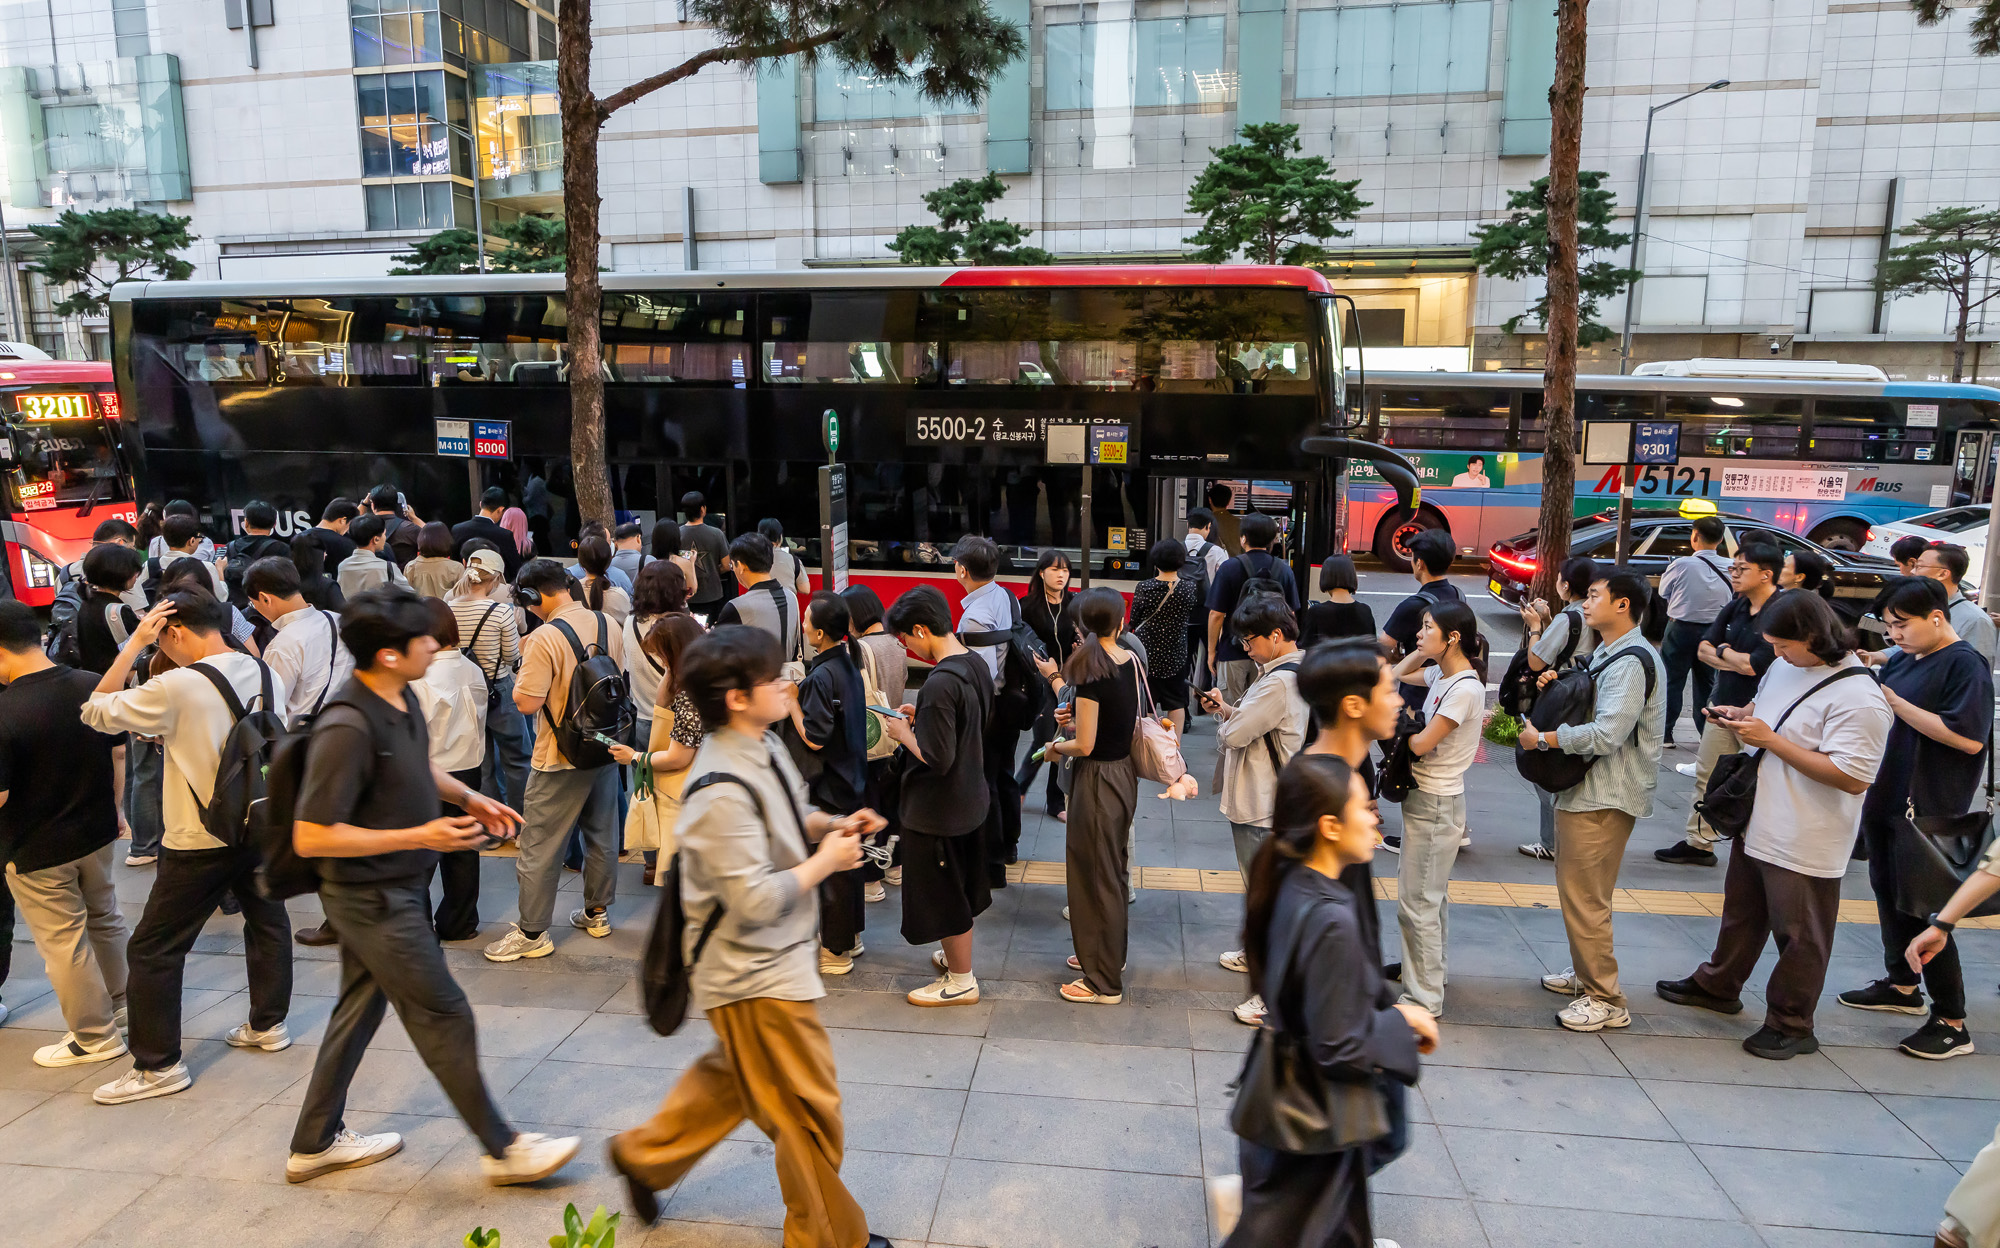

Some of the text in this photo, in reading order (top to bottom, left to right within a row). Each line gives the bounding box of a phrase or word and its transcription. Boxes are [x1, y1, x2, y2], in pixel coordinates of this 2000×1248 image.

[26, 397, 84, 418] 3201
[917, 416, 986, 440] 5500-2
[439, 441, 469, 451] M4101
[477, 442, 505, 454] 5000
[1103, 444, 1124, 457] 5500-2
[1642, 443, 1670, 455] 9301
[38, 481, 53, 493] 28
[1817, 476, 1843, 489] 서울역
[25, 499, 55, 508] 입석금지
